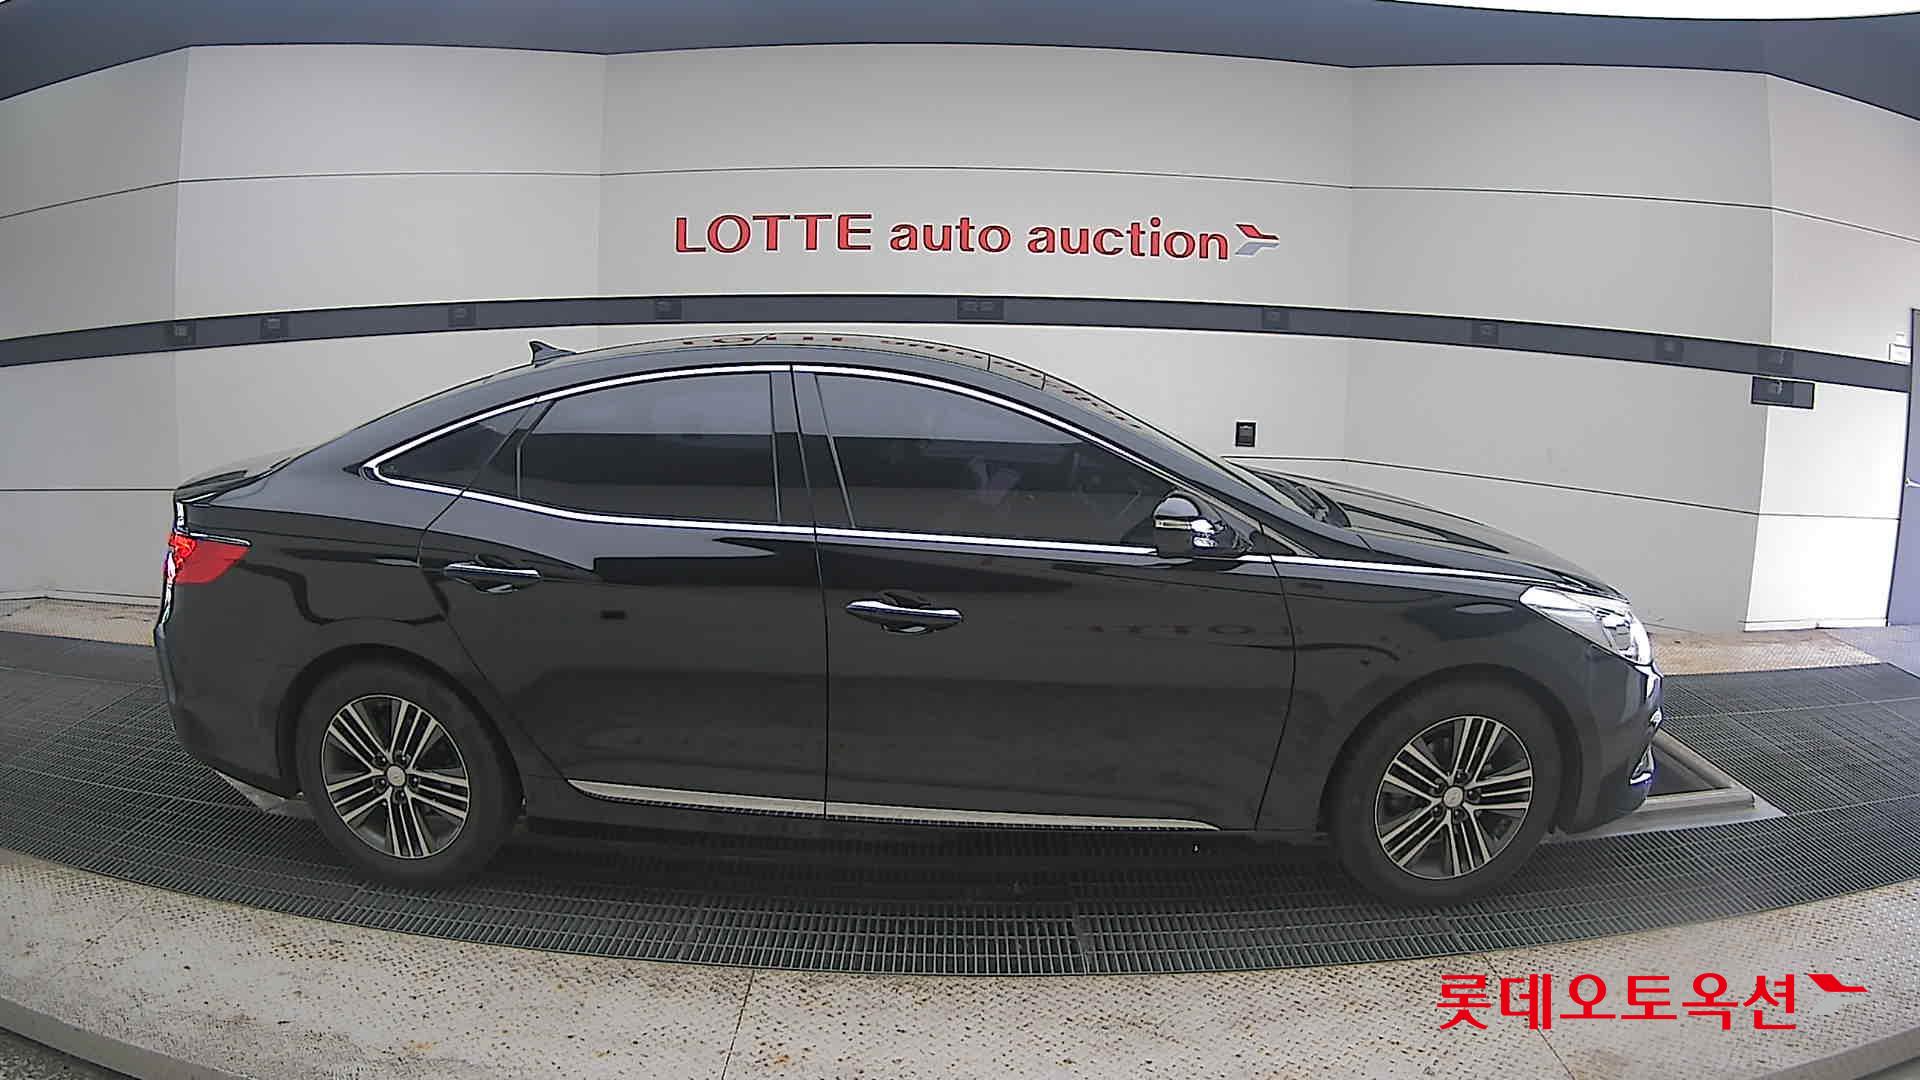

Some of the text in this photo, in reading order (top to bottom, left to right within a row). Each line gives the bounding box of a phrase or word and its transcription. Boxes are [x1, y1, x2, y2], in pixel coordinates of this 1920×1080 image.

[675, 213, 1229, 260] LOTTE auto auction
